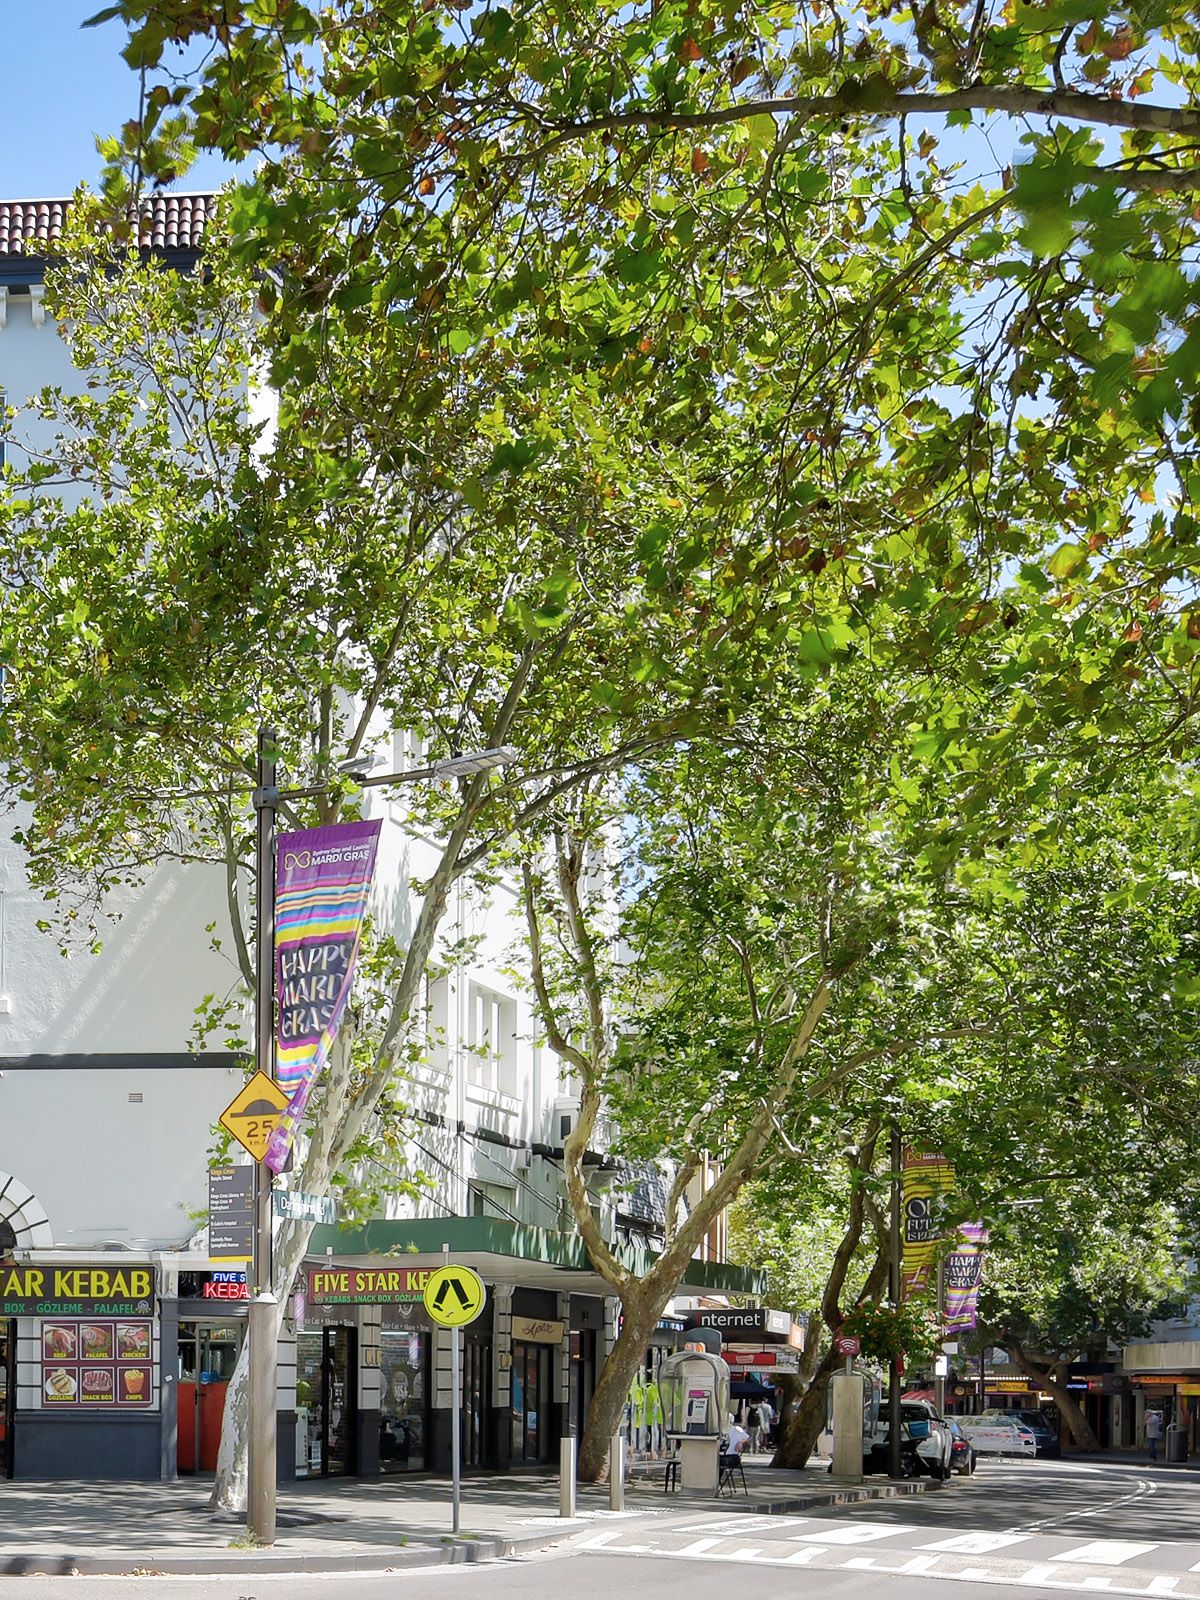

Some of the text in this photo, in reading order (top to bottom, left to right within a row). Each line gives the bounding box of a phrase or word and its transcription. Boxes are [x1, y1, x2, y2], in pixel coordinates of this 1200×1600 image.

[311, 850, 370, 866] MARDI GRAS
[246, 1120, 274, 1138] 25
[53, 1270, 151, 1298] KEBAB
[213, 1272, 236, 1282] FIVE
[314, 1273, 349, 1293] FIVE
[356, 1272, 400, 1292] STAR
[205, 1282, 249, 1299] KEBA
[324, 1295, 351, 1303] KEBABS
[354, 1295, 376, 1303] SNACK
[378, 1294, 391, 1302] BOX
[4, 1302, 26, 1313] BOX
[36, 1300, 83, 1313] GÖZLEME
[94, 1303, 135, 1314] FALAFEL
